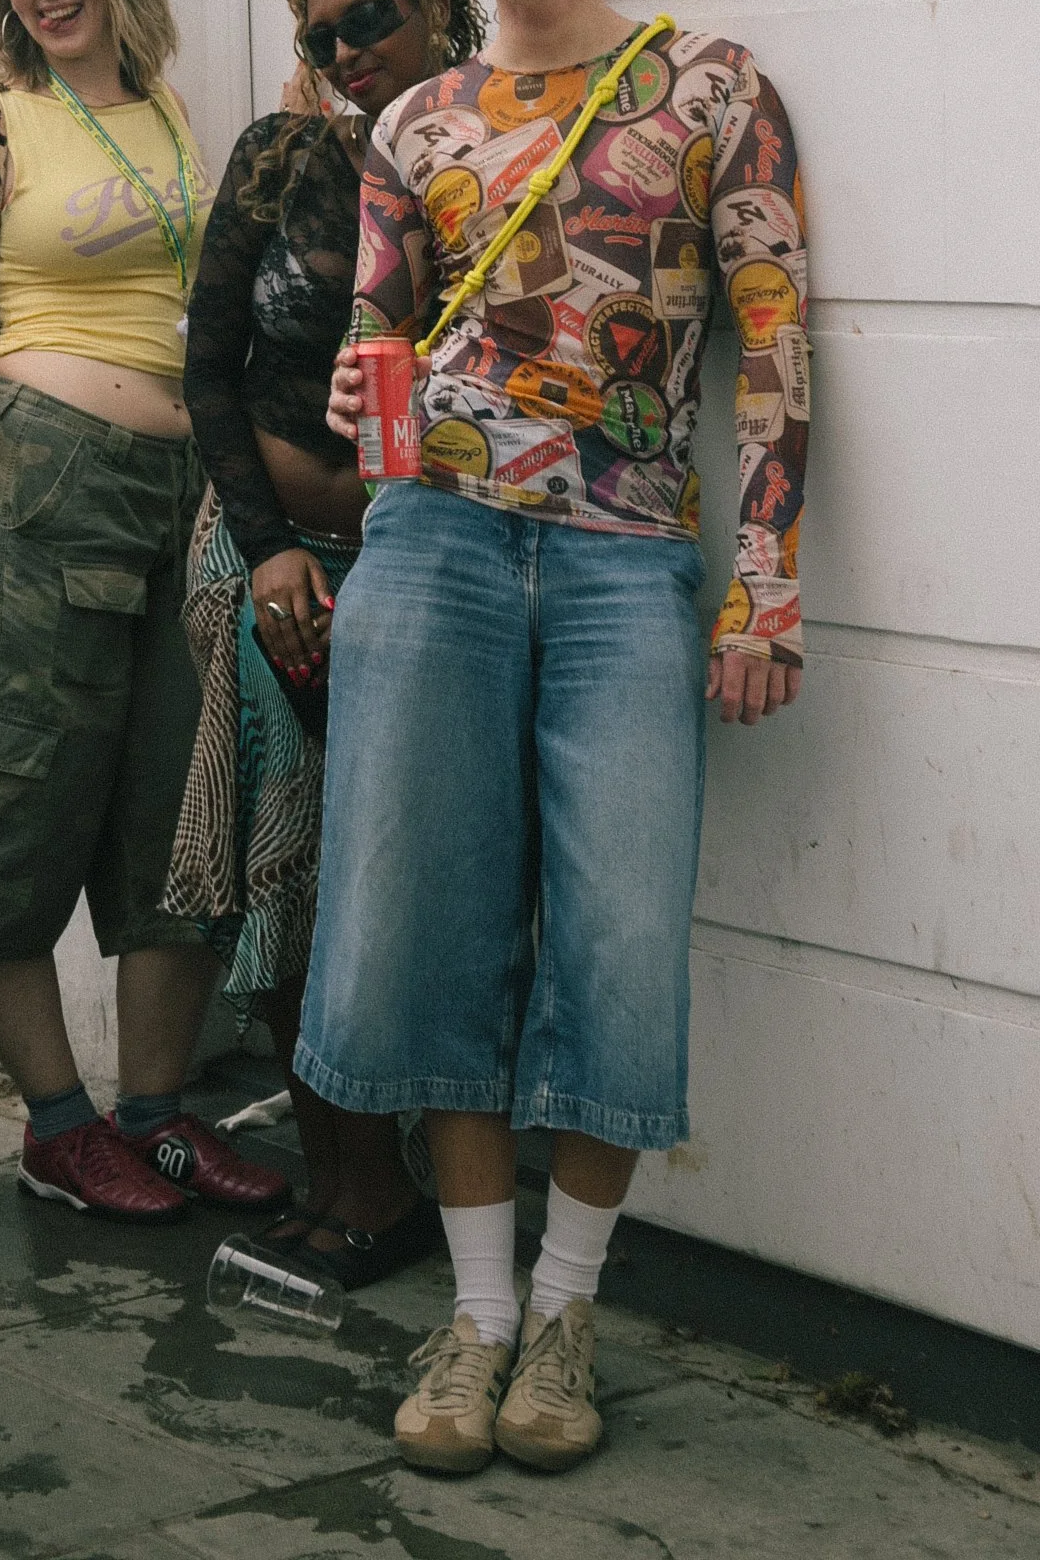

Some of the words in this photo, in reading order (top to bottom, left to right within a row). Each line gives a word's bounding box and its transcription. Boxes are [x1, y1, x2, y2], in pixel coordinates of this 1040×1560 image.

[755, 119, 782, 183] Mar
[393, 419, 422, 448] MA
[761, 461, 790, 520] Mar
[156, 1142, 186, 1178] 90
